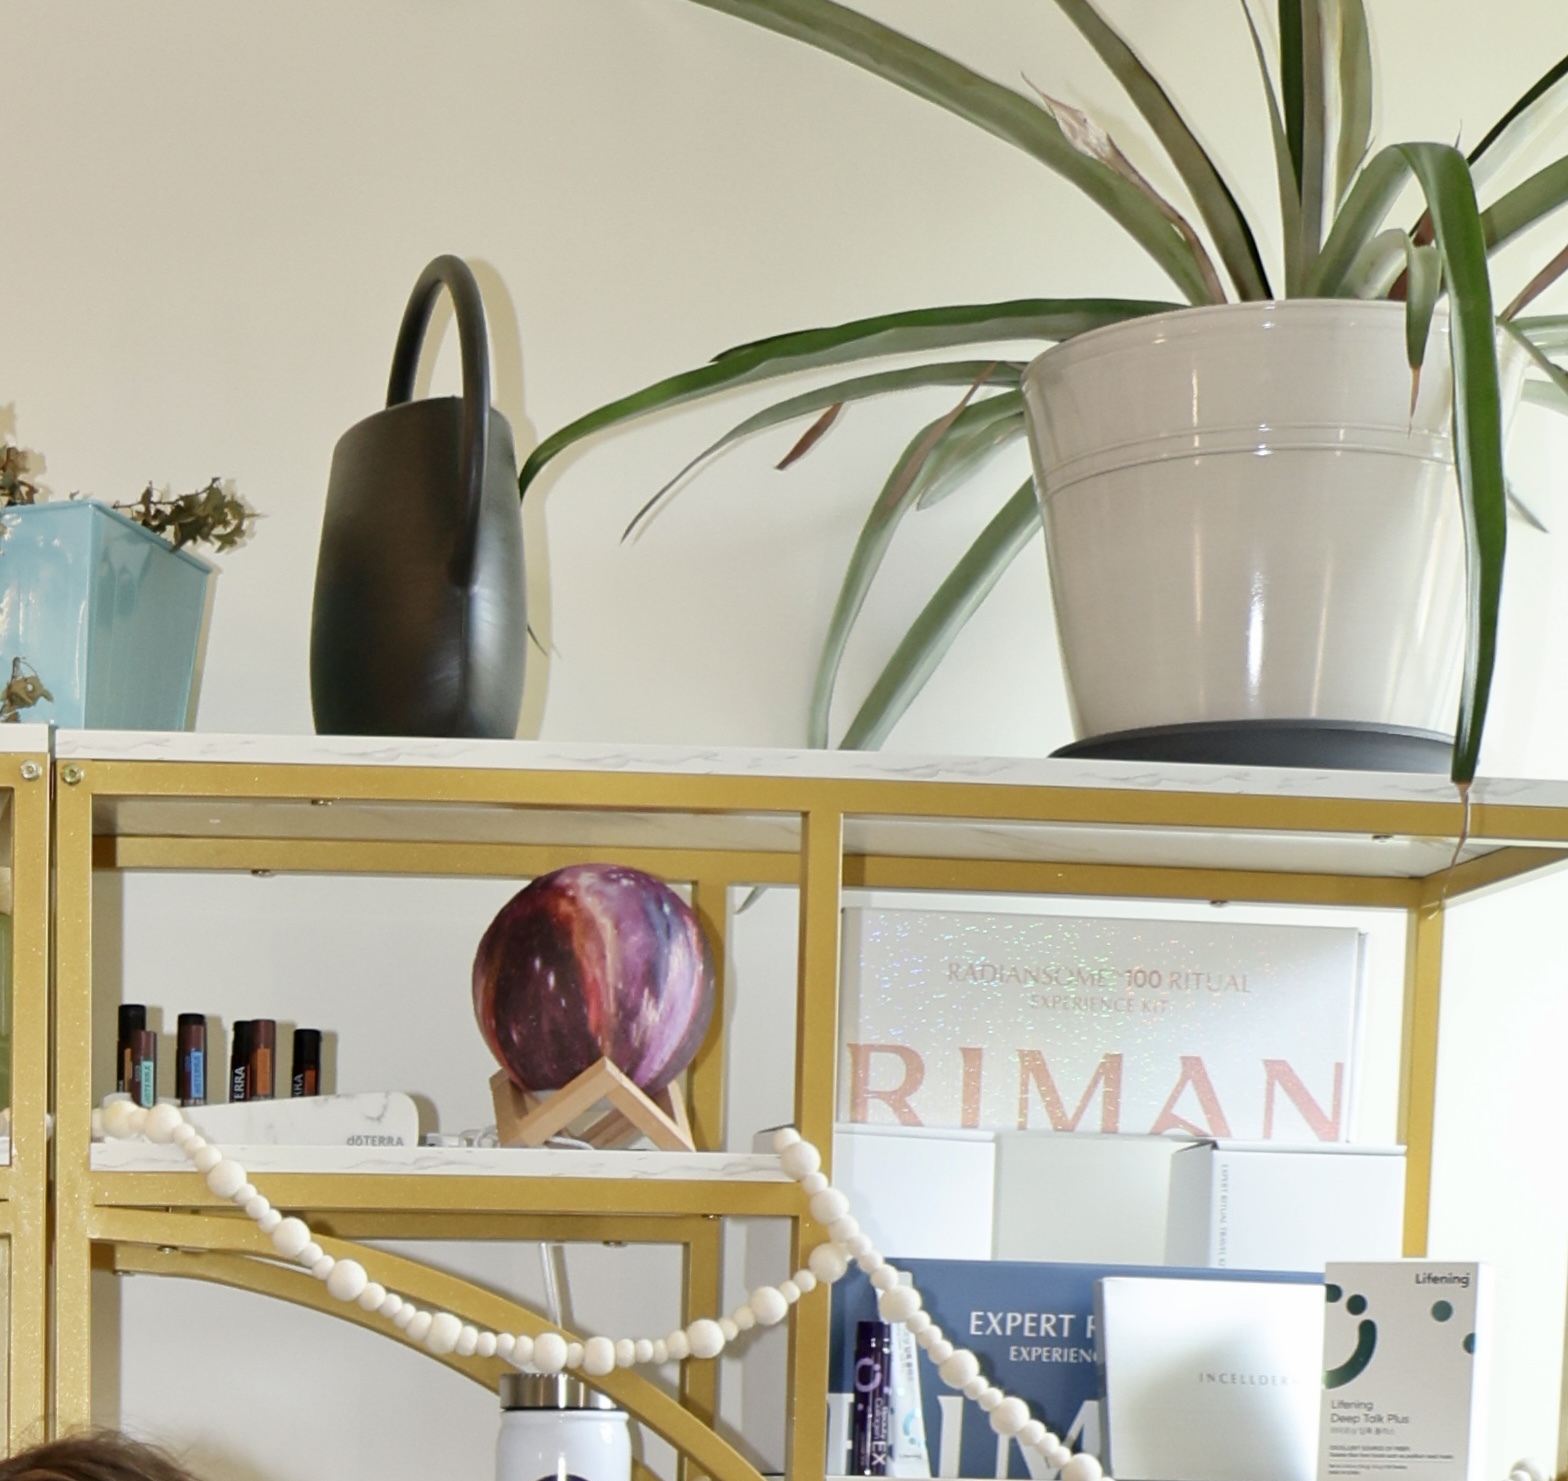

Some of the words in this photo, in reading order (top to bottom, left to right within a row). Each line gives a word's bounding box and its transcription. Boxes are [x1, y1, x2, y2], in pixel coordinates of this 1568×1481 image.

[1125, 968, 1162, 989] 100
[1169, 971, 1251, 993] RITUAL
[1031, 994, 1134, 1014] EXPERIENCE
[1141, 998, 1169, 1014] KIT
[846, 1042, 1346, 1142] RIMAN
[1415, 1273, 1470, 1288] Lifening
[970, 1311, 1076, 1338] EXPERT
[1009, 1346, 1097, 1363] EXPERIEN
[872, 1441, 887, 1466] EX
